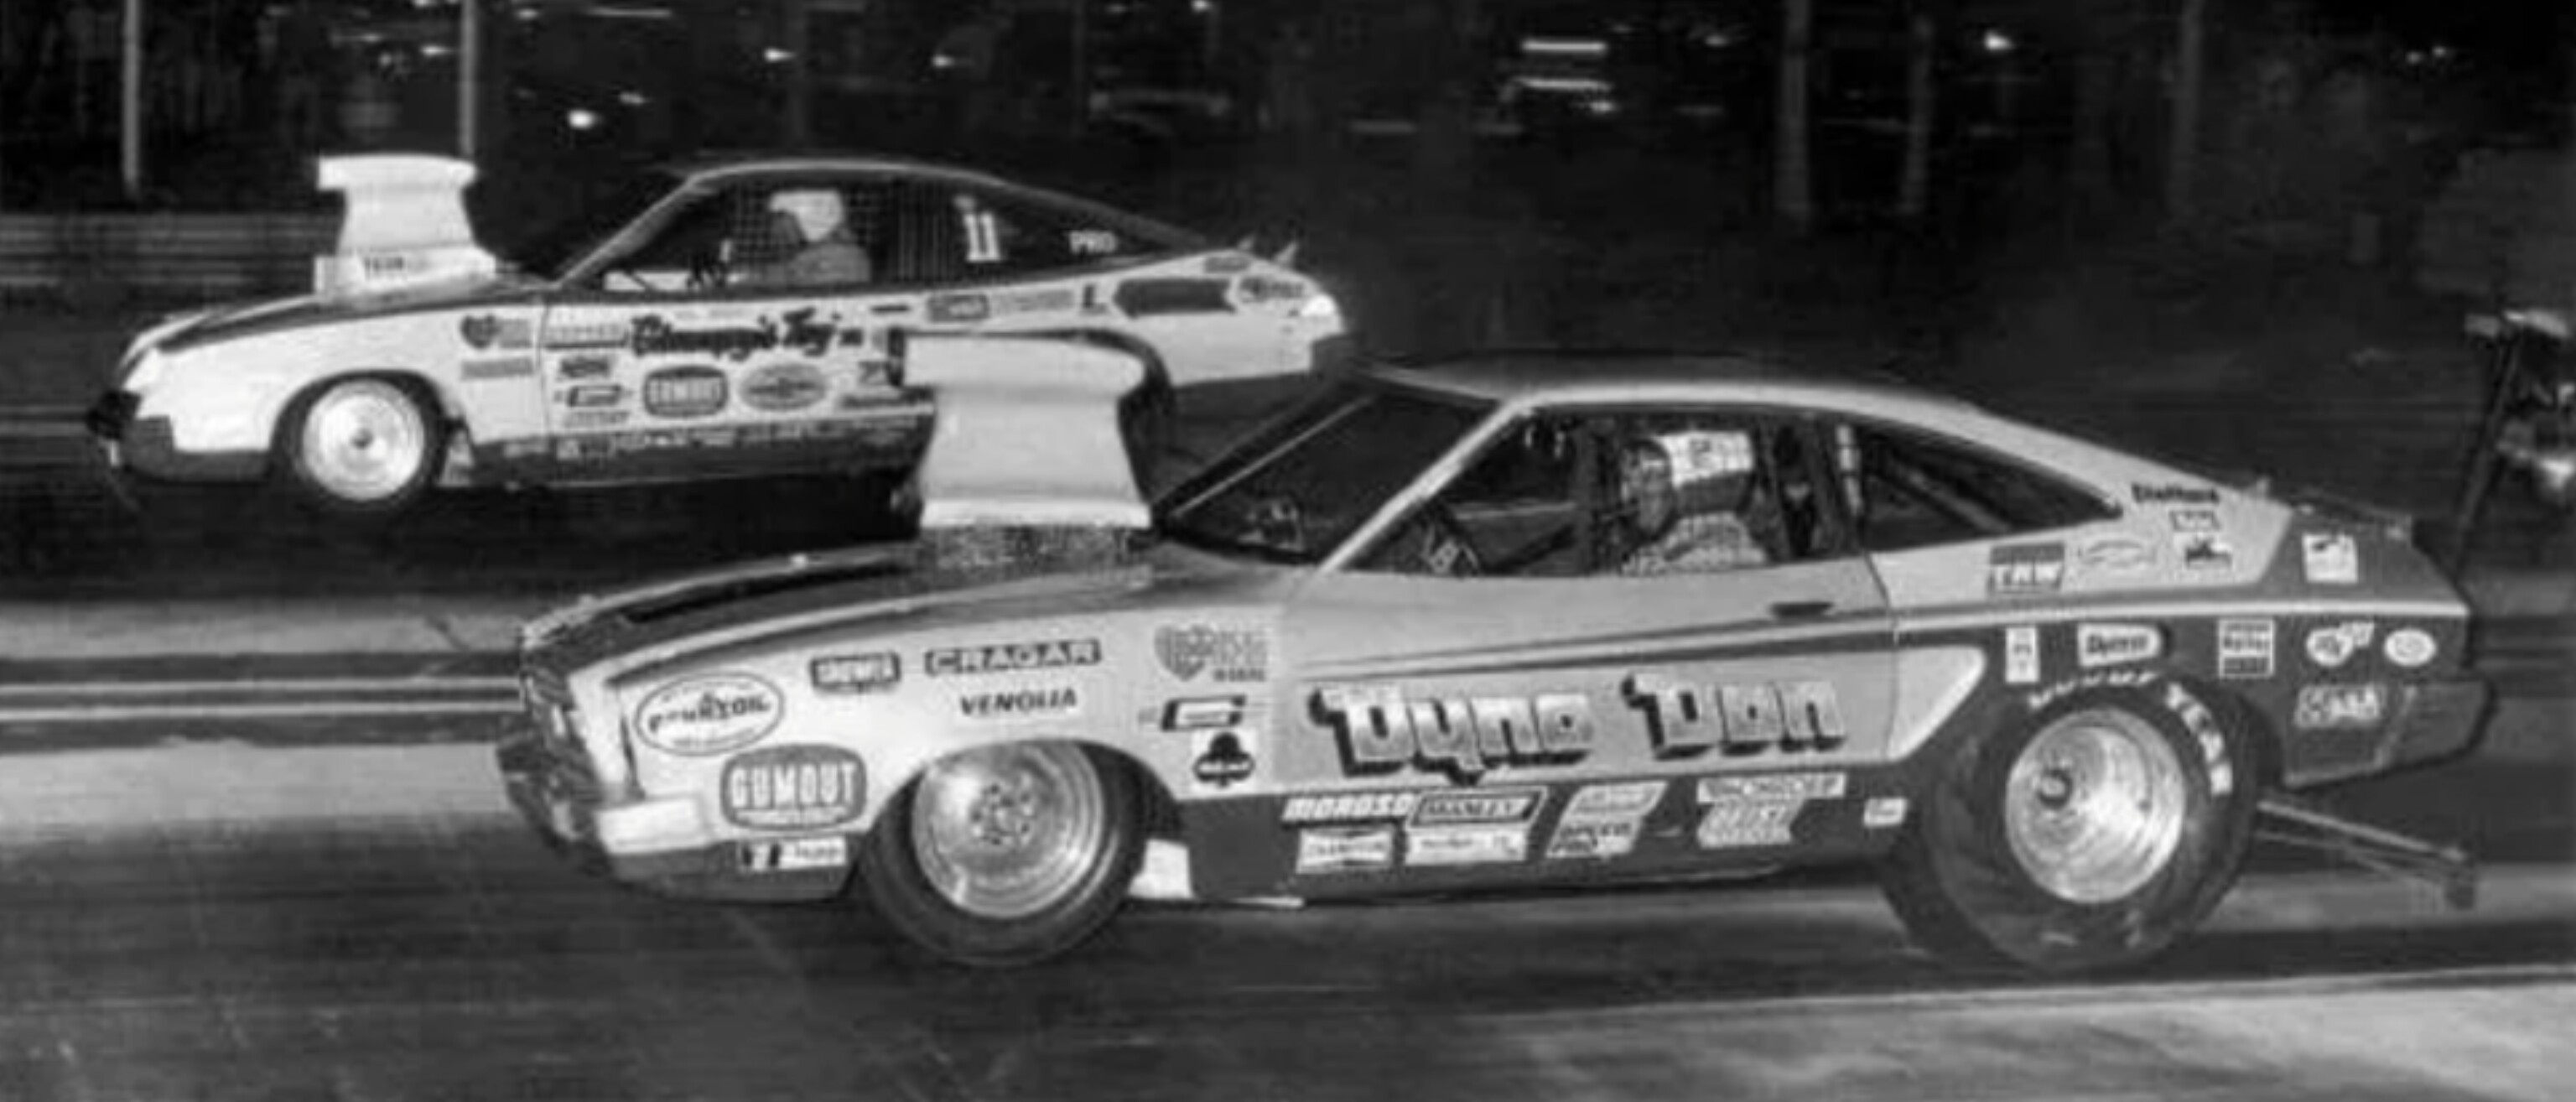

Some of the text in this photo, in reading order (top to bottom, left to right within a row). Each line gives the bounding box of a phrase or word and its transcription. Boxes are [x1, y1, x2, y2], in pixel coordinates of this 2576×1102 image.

[1069, 230, 1118, 253] PRO
[932, 641, 1100, 674] CRAGAR
[959, 688, 1078, 715] VENOLIA
[1309, 673, 1846, 787] Dyno Don
[730, 761, 858, 809] GUMOUT
[1281, 792, 1417, 824] MOROSO
